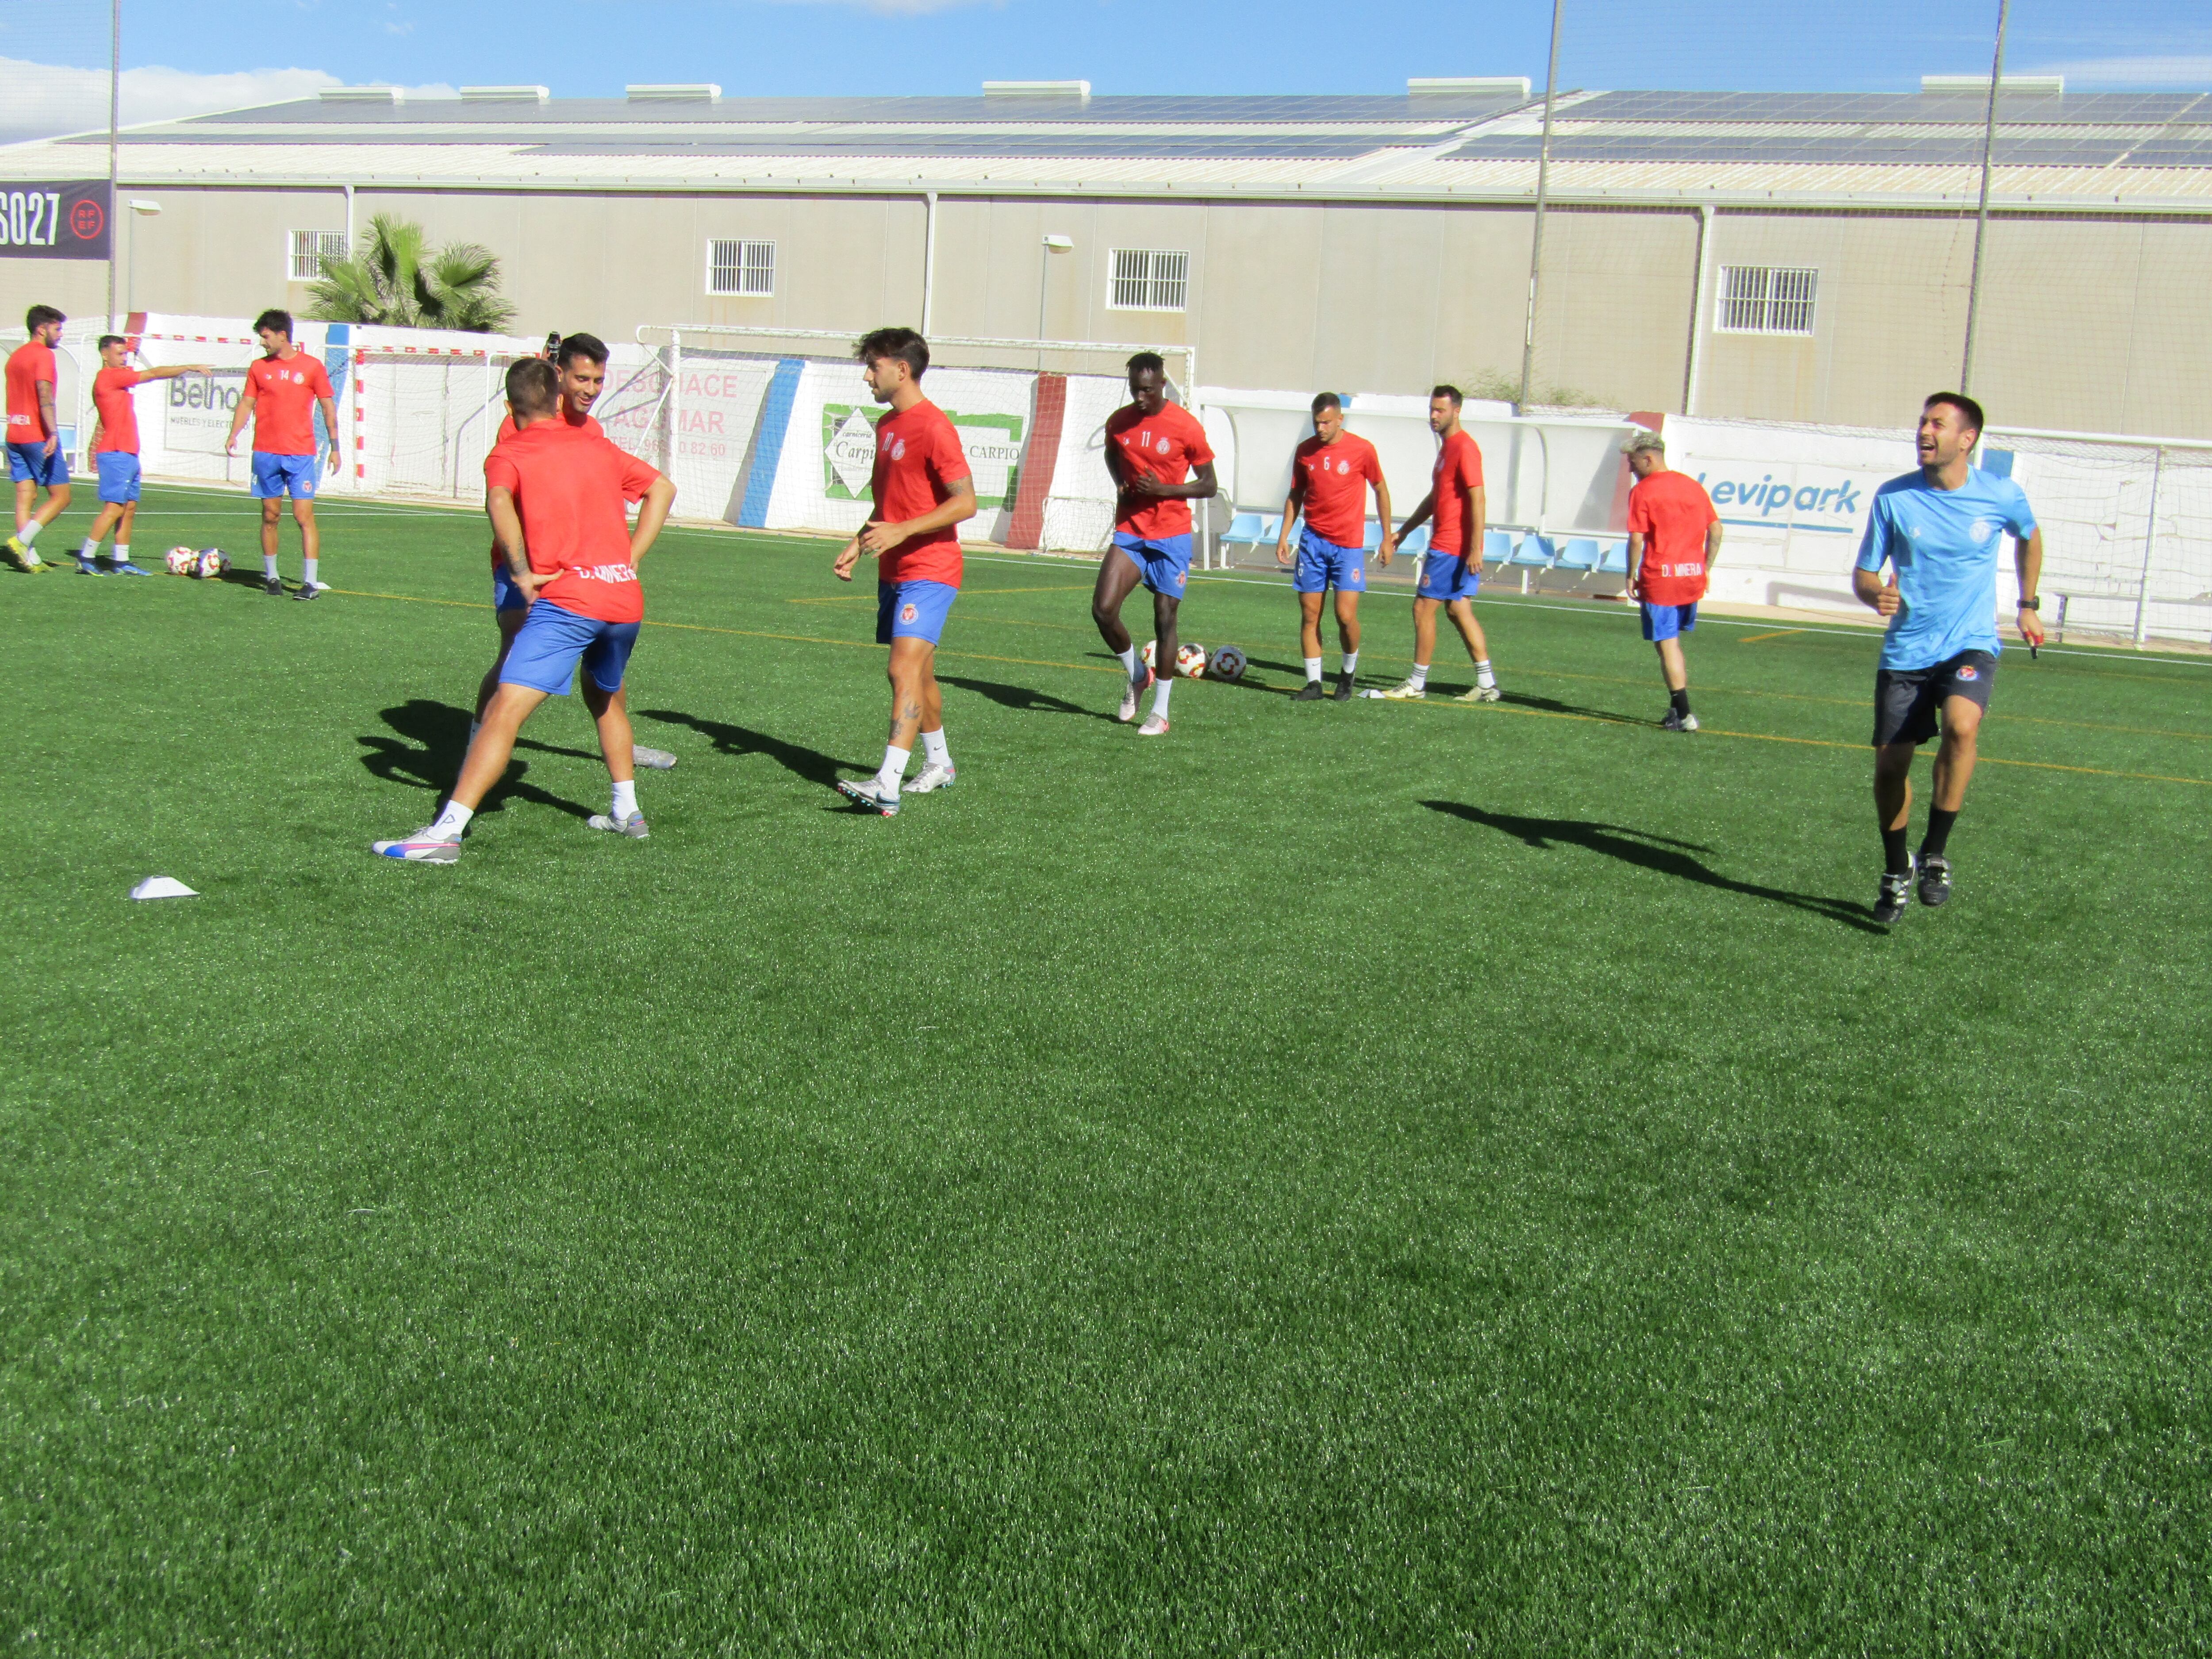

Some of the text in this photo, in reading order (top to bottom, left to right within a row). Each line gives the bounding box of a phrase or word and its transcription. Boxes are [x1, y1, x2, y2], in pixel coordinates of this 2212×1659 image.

[280, 369, 289, 380] 14
[170, 375, 240, 411] Belho
[170, 416, 200, 426] MUEBLES
[202, 418, 207, 427] Y
[1141, 431, 1151, 447] 11
[691, 442, 706, 455] 82
[710, 443, 725, 455] 60
[836, 441, 875, 464] Carpi
[970, 445, 1020, 460] CARPIO
[1324, 456, 1330, 470] 6
[1661, 563, 1701, 577] D. MINERA
